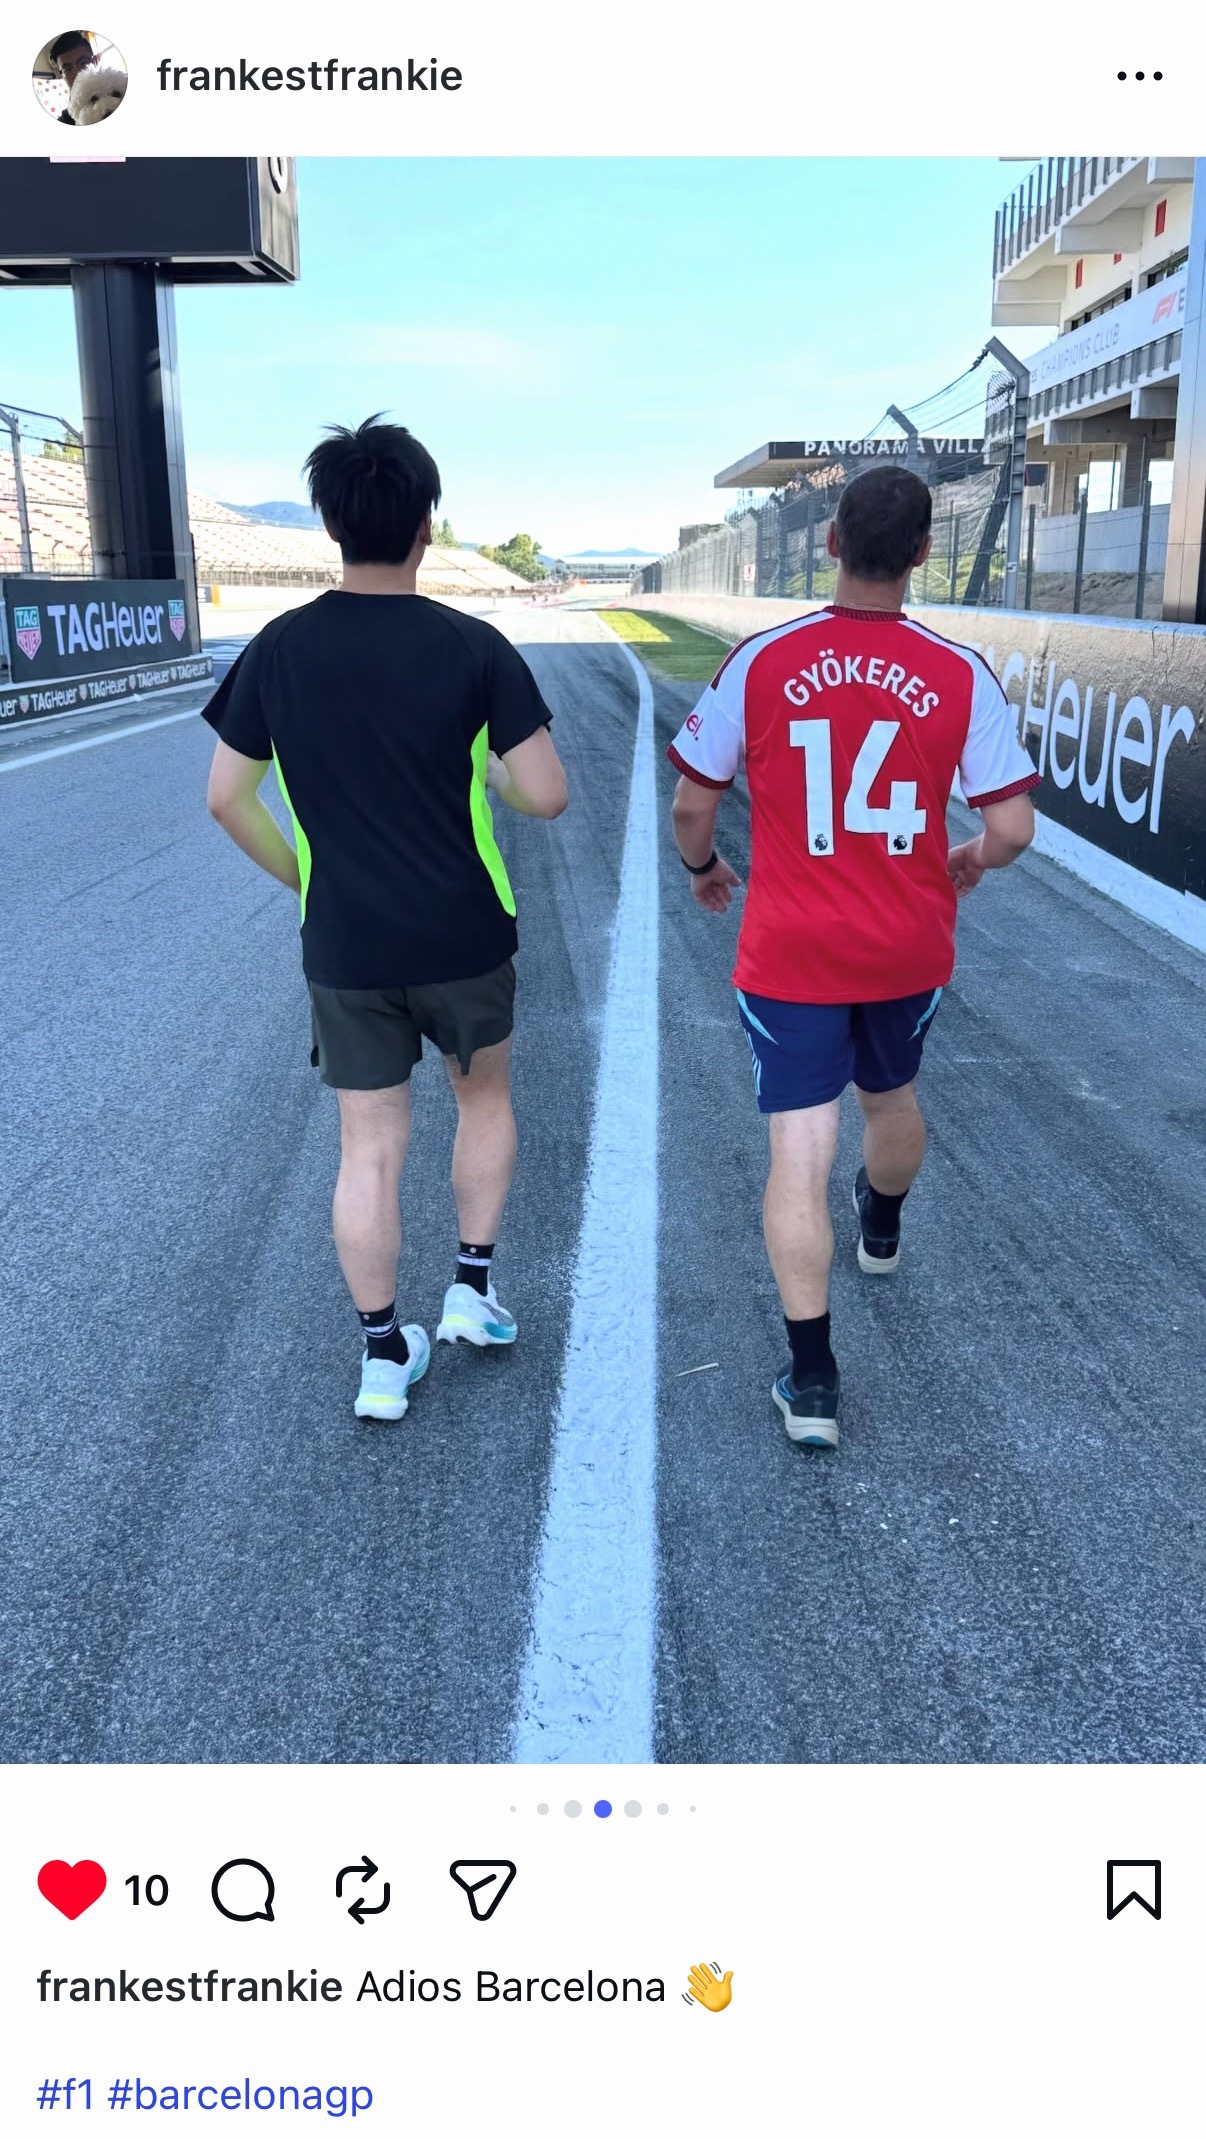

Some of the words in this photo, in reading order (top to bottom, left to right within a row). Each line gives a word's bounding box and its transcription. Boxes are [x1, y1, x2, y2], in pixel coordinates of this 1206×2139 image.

[1041, 338, 1092, 380] CHAMPIONS
[1094, 323, 1120, 355] CLUB
[804, 439, 926, 456] PANORAMA
[16, 610, 38, 627] TAG
[784, 648, 940, 718] GYÖKERES
[789, 718, 927, 857] 14
